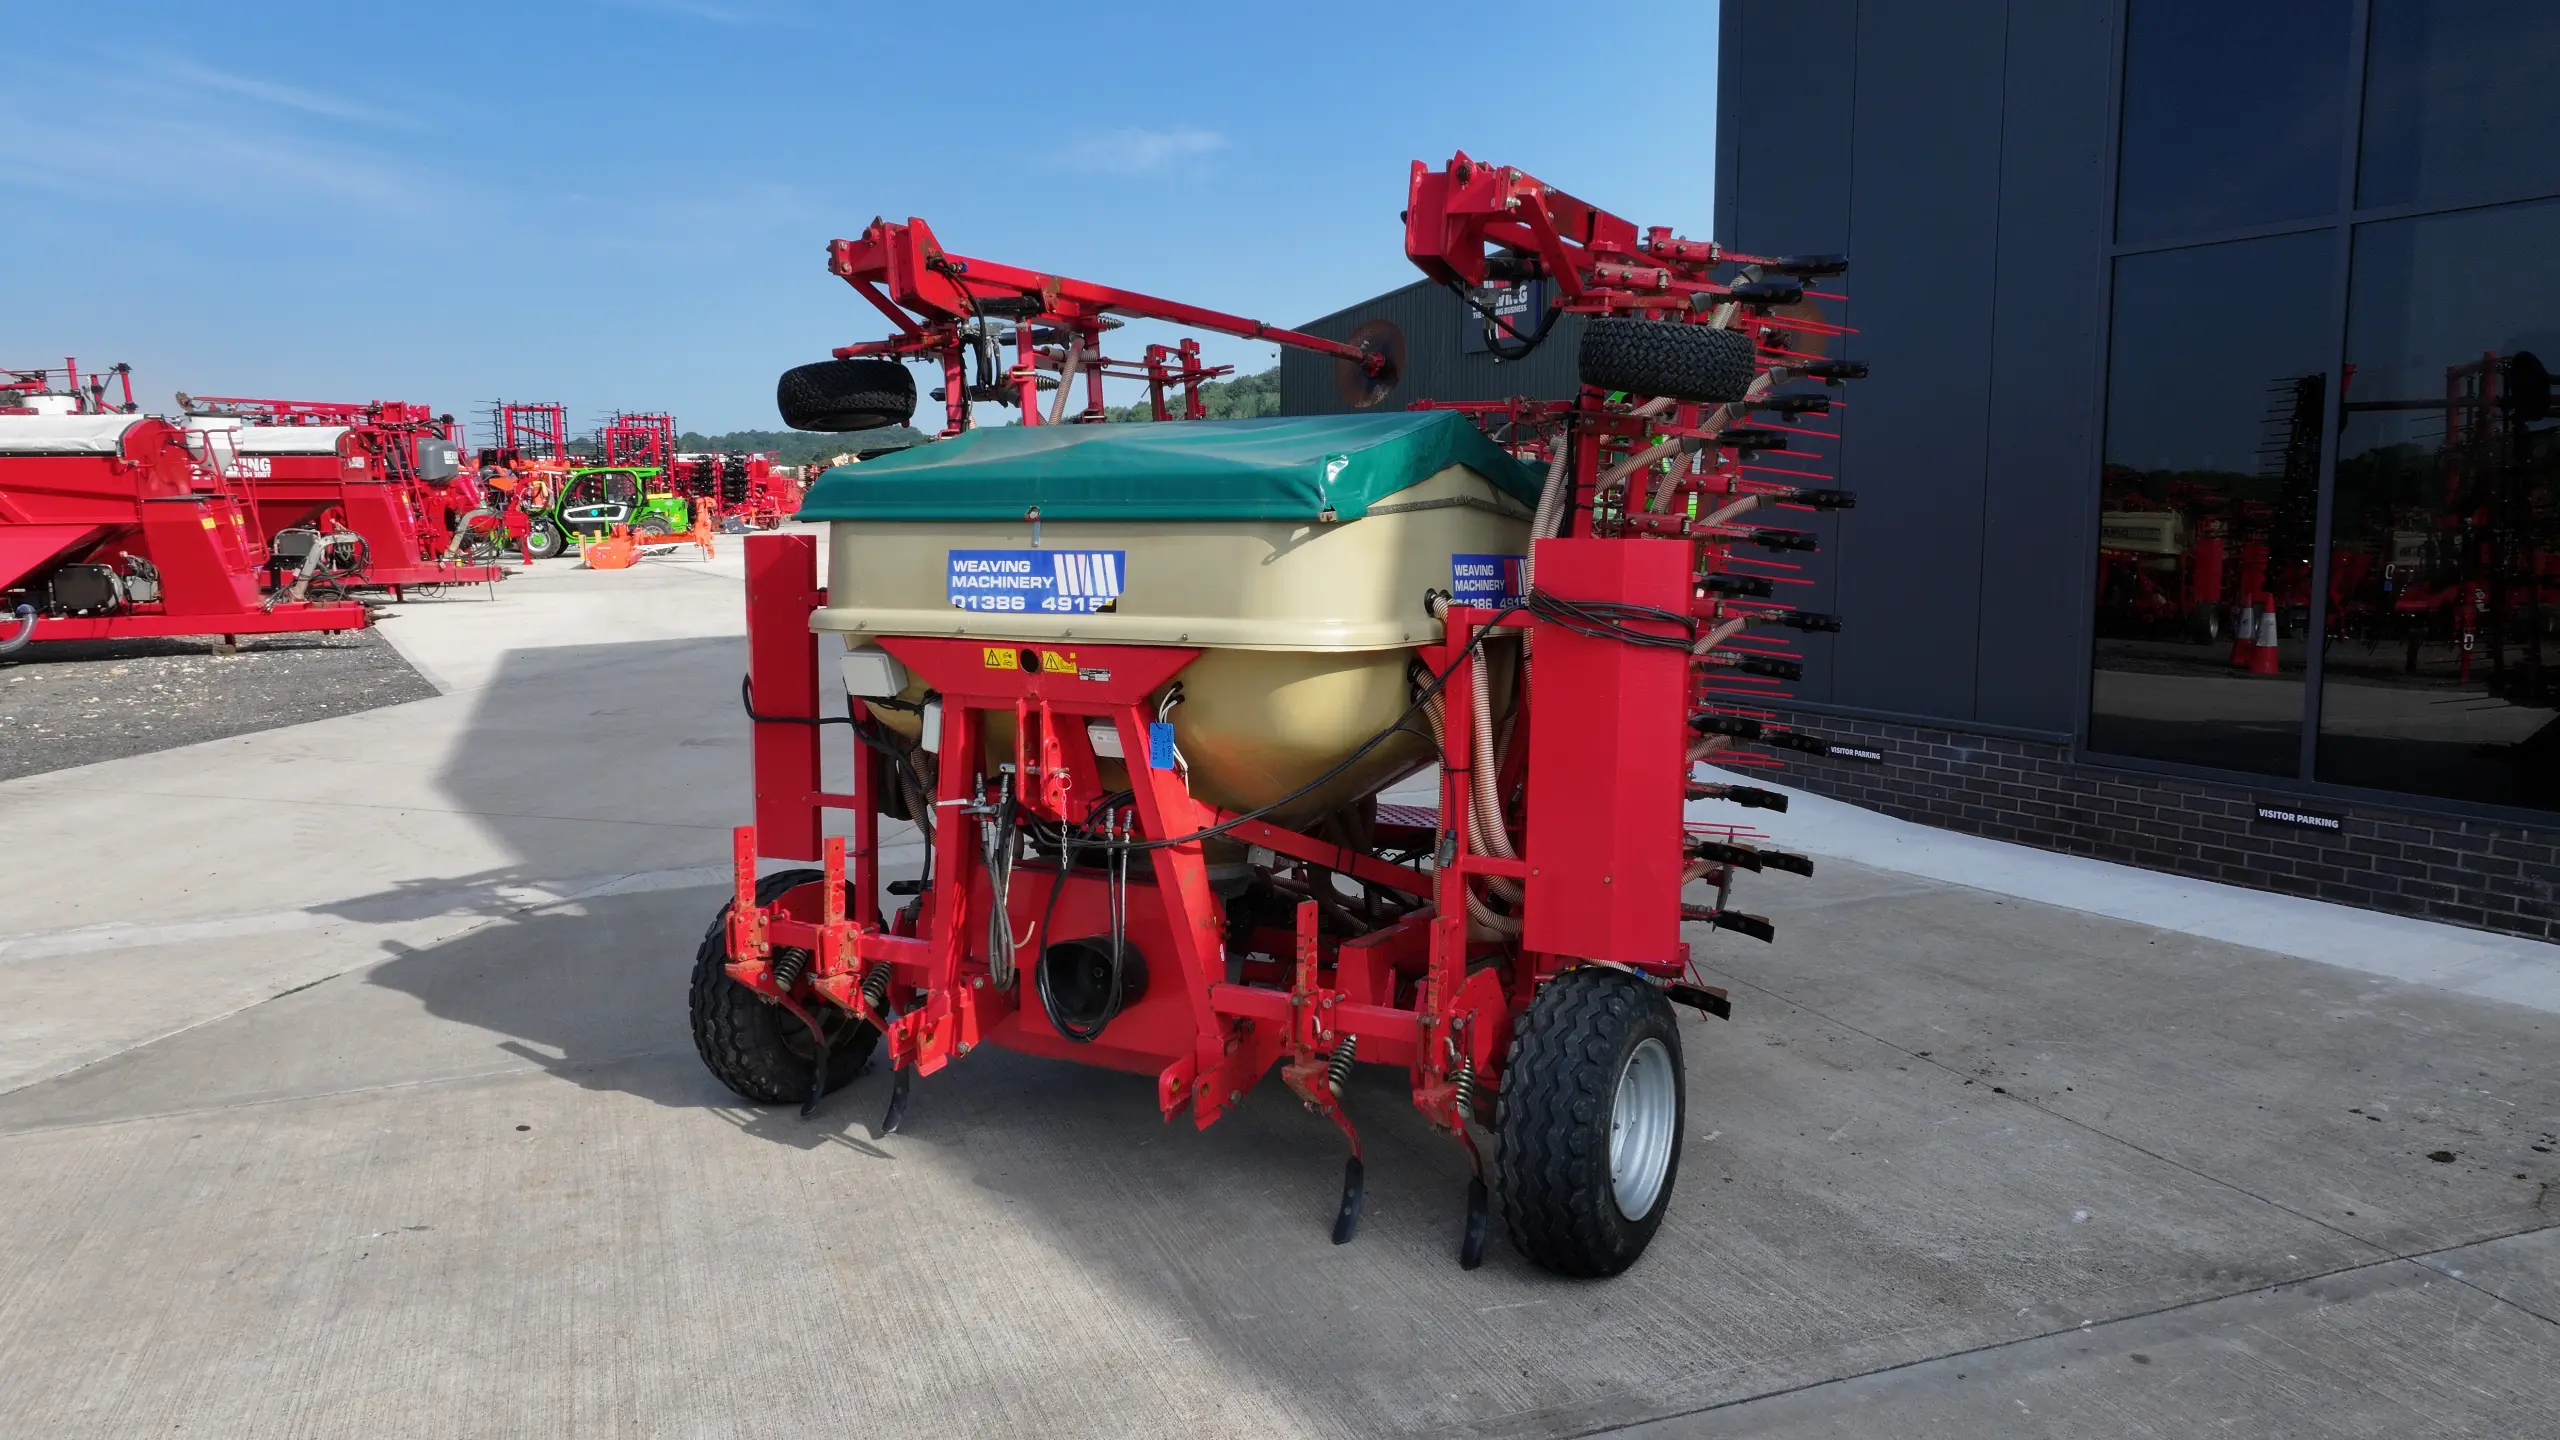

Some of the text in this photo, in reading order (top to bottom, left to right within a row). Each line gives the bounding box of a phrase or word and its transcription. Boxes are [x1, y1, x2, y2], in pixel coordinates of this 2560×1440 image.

[1504, 304, 1528, 315] BUSINESS
[953, 560, 1031, 573] WEAVING
[1454, 564, 1494, 577] WEAVING
[952, 576, 1054, 588] MACHINERY
[1455, 579, 1505, 591] MACHINERY
[951, 595, 1026, 610] 01386
[1831, 746, 1881, 760] VISITOR PARKING
[2259, 809, 2339, 828] VISITOR PARKING
